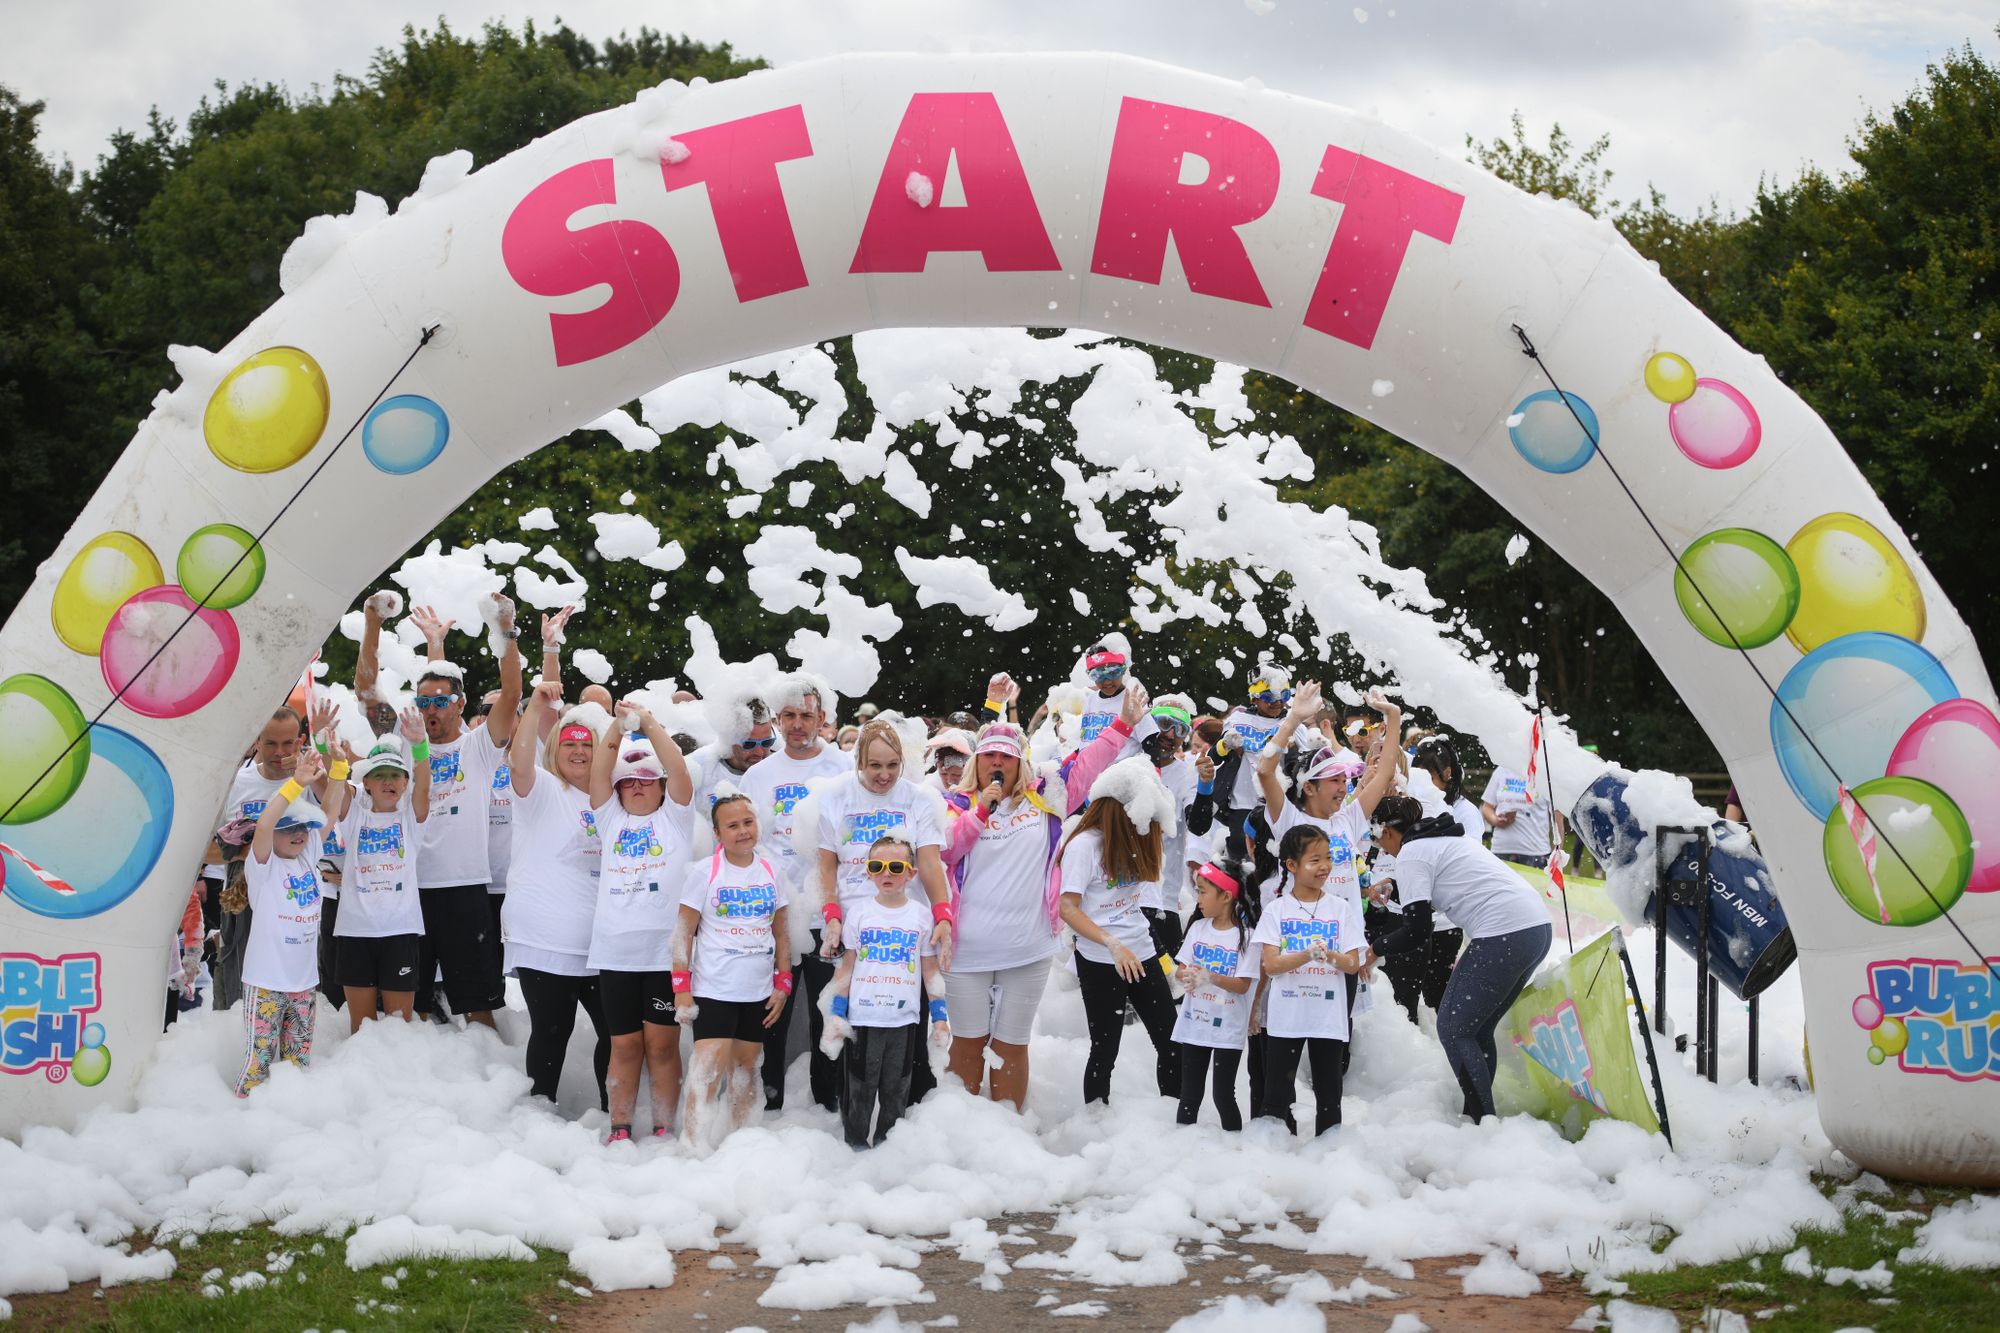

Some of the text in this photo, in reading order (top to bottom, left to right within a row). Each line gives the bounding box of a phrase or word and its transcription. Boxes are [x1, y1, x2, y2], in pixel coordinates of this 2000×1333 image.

[501, 92, 1466, 367] START
[775, 785, 809, 800] BUB
[719, 885, 776, 904] BUBBLE
[1688, 860, 1769, 928] MBN FC-0
[728, 901, 775, 917] RUSH
[861, 929, 918, 948] BUBBLE
[1280, 920, 1337, 939] BUBBLE
[868, 945, 911, 962] RUSH
[1196, 944, 1238, 966] UBBLE
[0, 961, 94, 1013] BLE
[1875, 964, 2000, 1022] BUB
[3, 1014, 78, 1066] SH
[1907, 1018, 2000, 1073] RU
